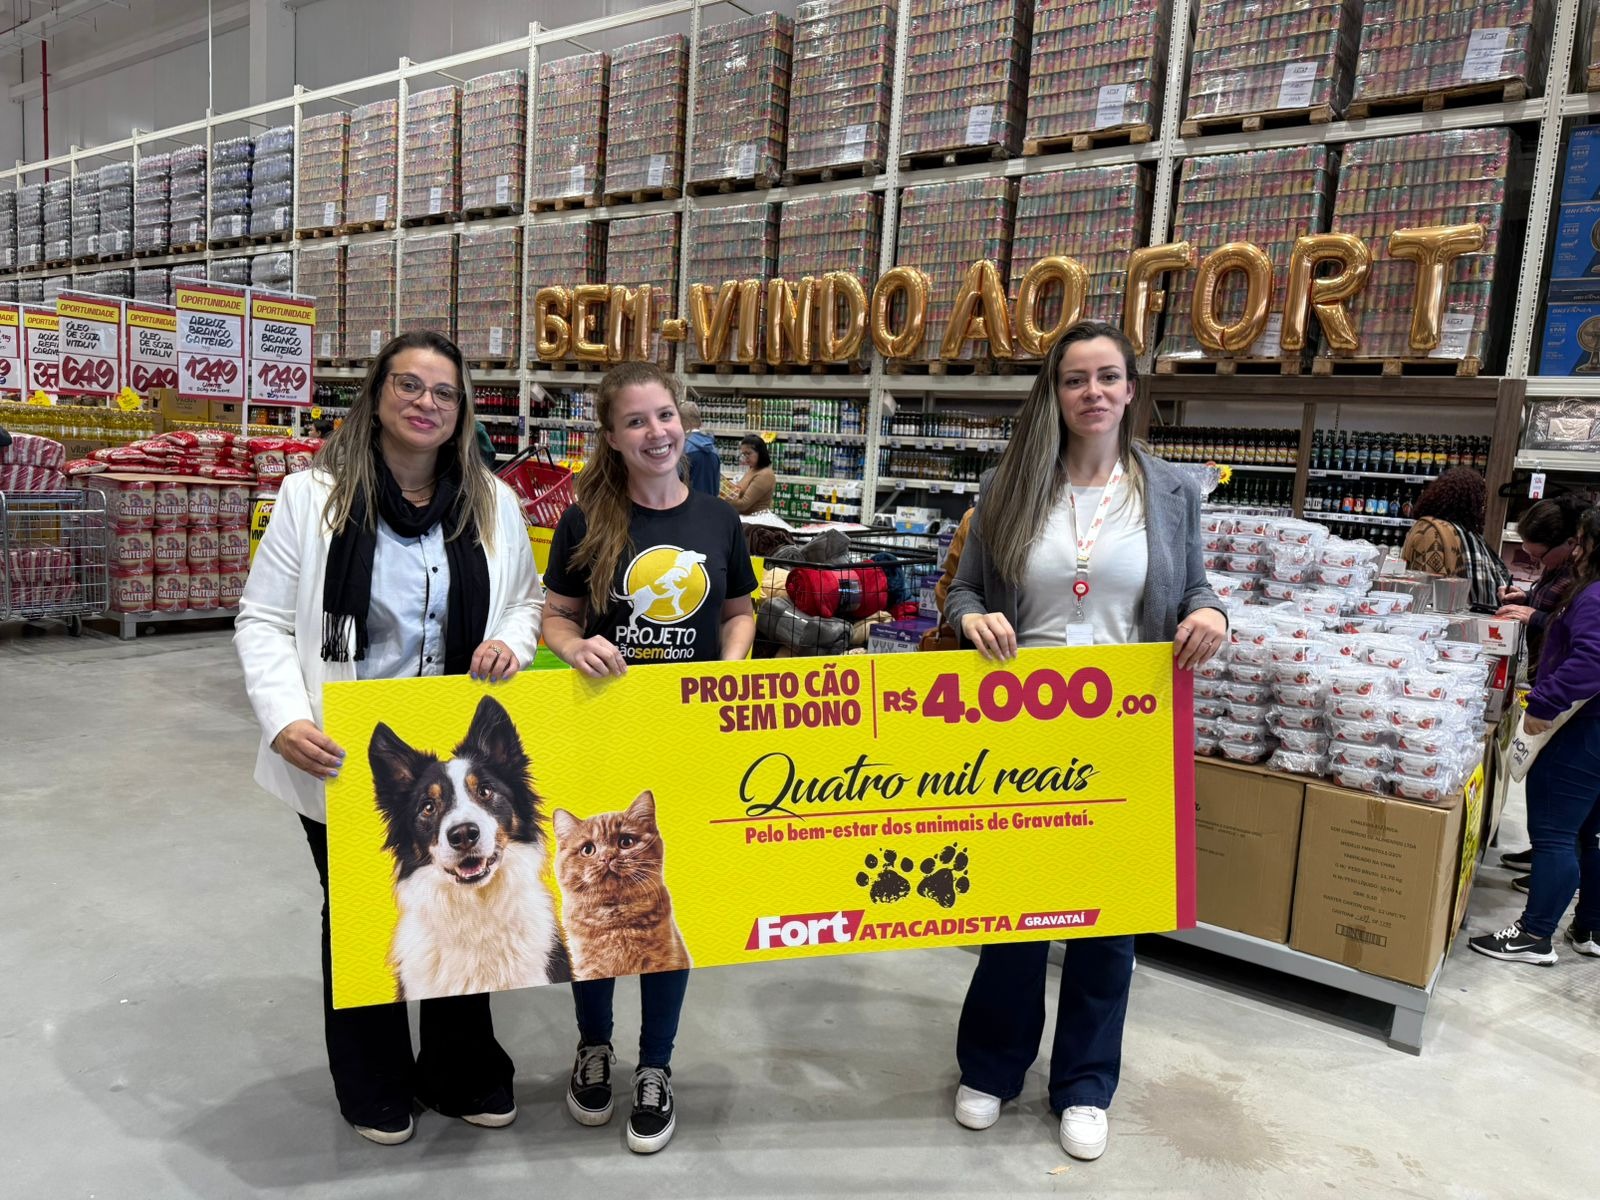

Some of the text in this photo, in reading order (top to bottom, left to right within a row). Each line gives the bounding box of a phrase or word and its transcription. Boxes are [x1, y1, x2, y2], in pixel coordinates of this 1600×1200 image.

[940, 255, 1090, 359] AO
[1124, 222, 1488, 356] FORT
[181, 295, 241, 310] OPORTUNIDADE
[60, 303, 115, 318] OPORTUNIDADE
[256, 304, 312, 320] OPORTUNIDADE
[66, 320, 90, 332] ÓLEO
[130, 313, 176, 327] OPORTUNIDAD
[189, 315, 227, 329] ARROZ
[66, 330, 101, 342] DE SOJA
[139, 330, 161, 341] ÓLEO
[188, 325, 231, 339] BRANCO
[263, 323, 298, 337] ARROZ
[139, 340, 174, 350] DE SOJA
[185, 334, 234, 349] GAITEIRO
[261, 333, 302, 347] BRANCO
[139, 346, 173, 358] VITALIV
[260, 343, 303, 356] GAITEIRO
[120, 502, 152, 516] GAITEIRO
[155, 501, 187, 515] GAITEIRO
[188, 500, 218, 514] GAITEIRO
[220, 499, 248, 513] GAITEIRO
[120, 546, 152, 560] GAITEIRO
[220, 544, 249, 556] GAITEIRO
[121, 588, 153, 602] GAITEIRO
[157, 586, 188, 600] GAITEIRO
[615, 625, 697, 645] PROJETO
[617, 643, 694, 660] ãosemdono
[680, 662, 861, 704] PROJETO CÃO
[883, 687, 918, 714] R$
[719, 699, 861, 733] SEM DONO
[739, 748, 1100, 822] Quatro mil reais
[745, 809, 1094, 844] Pelo bem-estar dos animais de Gravataí.
[757, 910, 1086, 950] Fort ATACADISTA GRAVATAÍ
